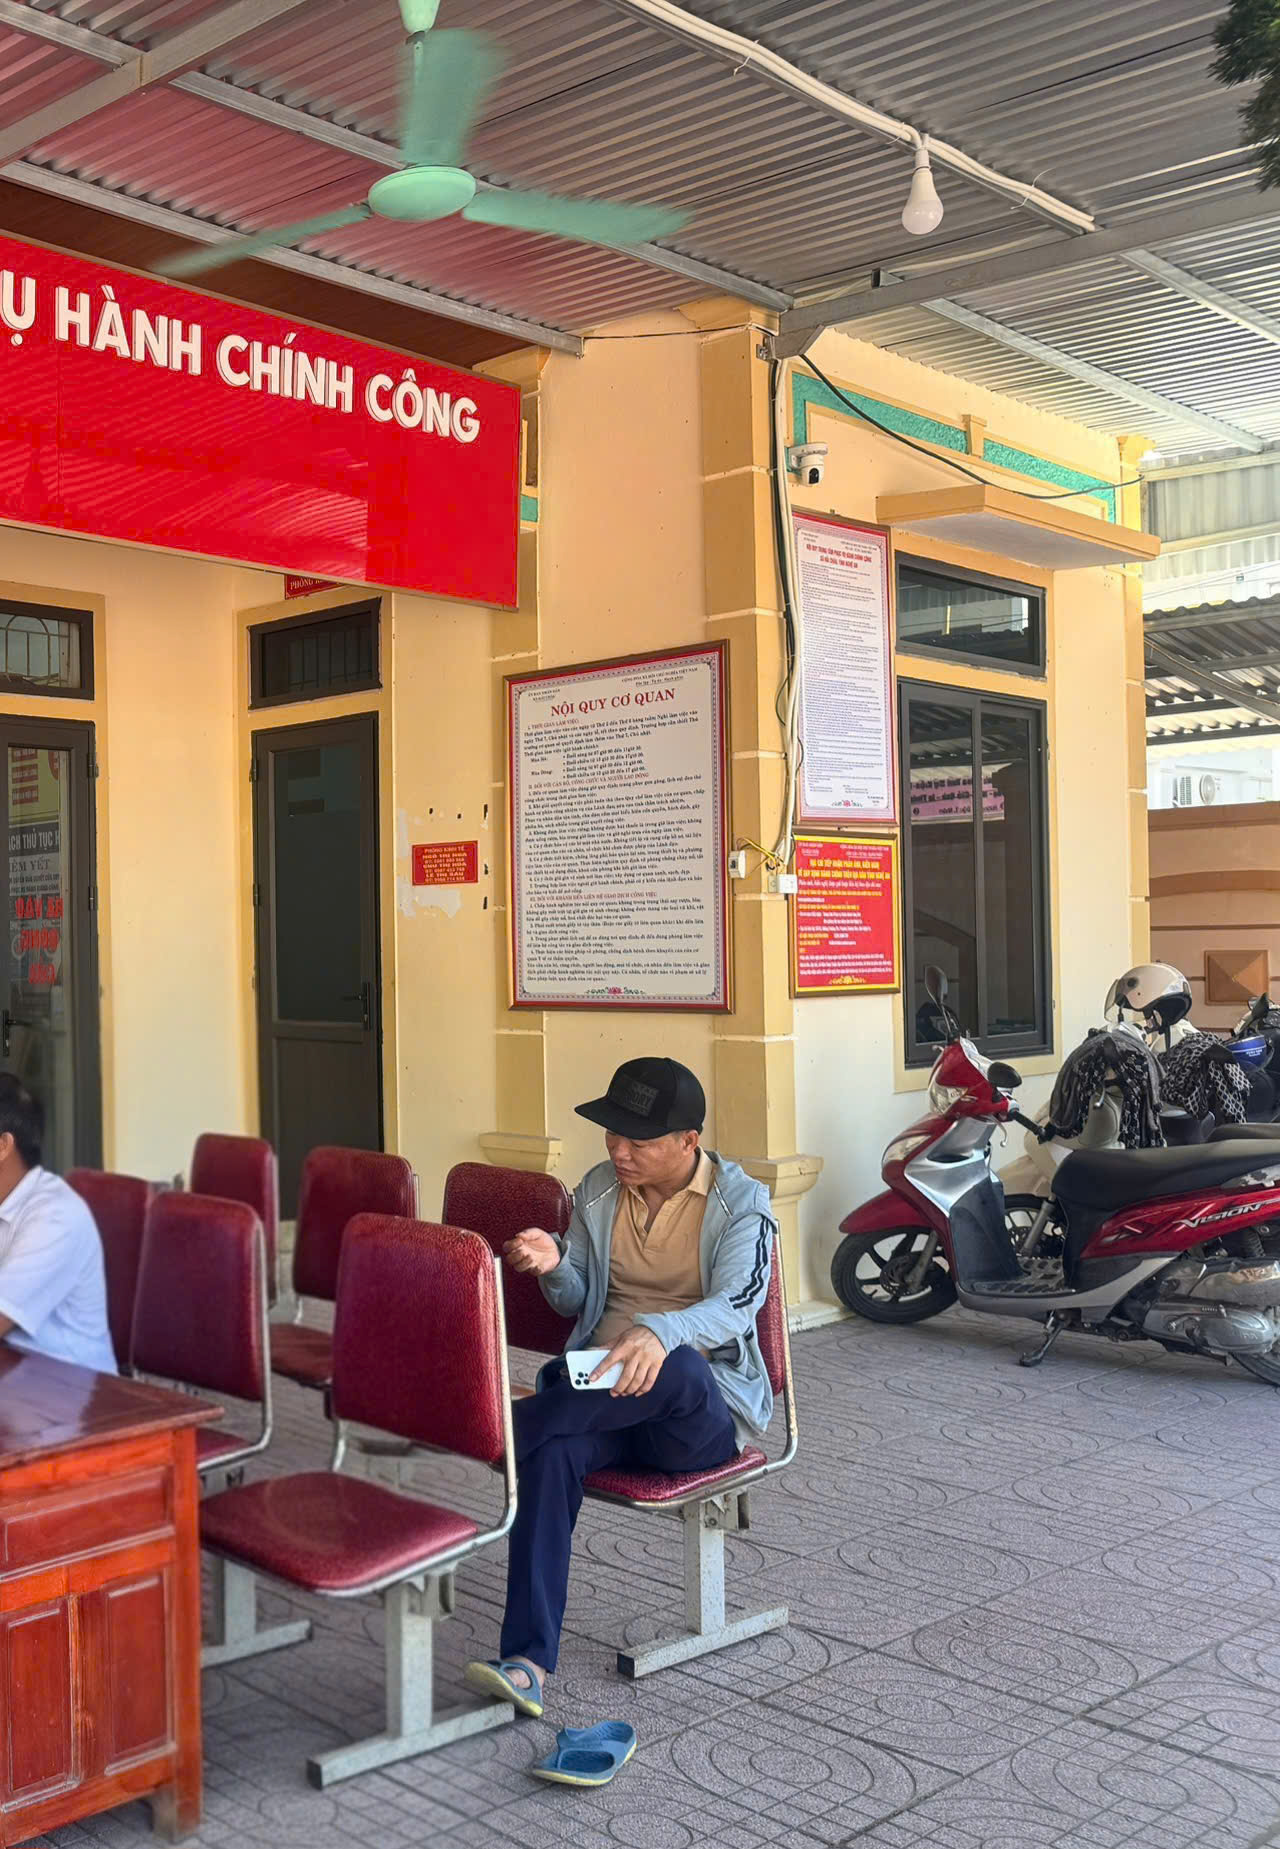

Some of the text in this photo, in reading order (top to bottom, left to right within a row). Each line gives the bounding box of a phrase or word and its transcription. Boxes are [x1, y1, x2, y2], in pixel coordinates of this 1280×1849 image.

[54, 283, 203, 377] HÀNH
[219, 332, 355, 415] CHÍNH
[366, 369, 482, 444] CÔNG
[551, 688, 675, 718] NỘI QUY CƠ QUAN
[39, 831, 53, 851] TỤC
[1172, 1203, 1263, 1228] VISION
